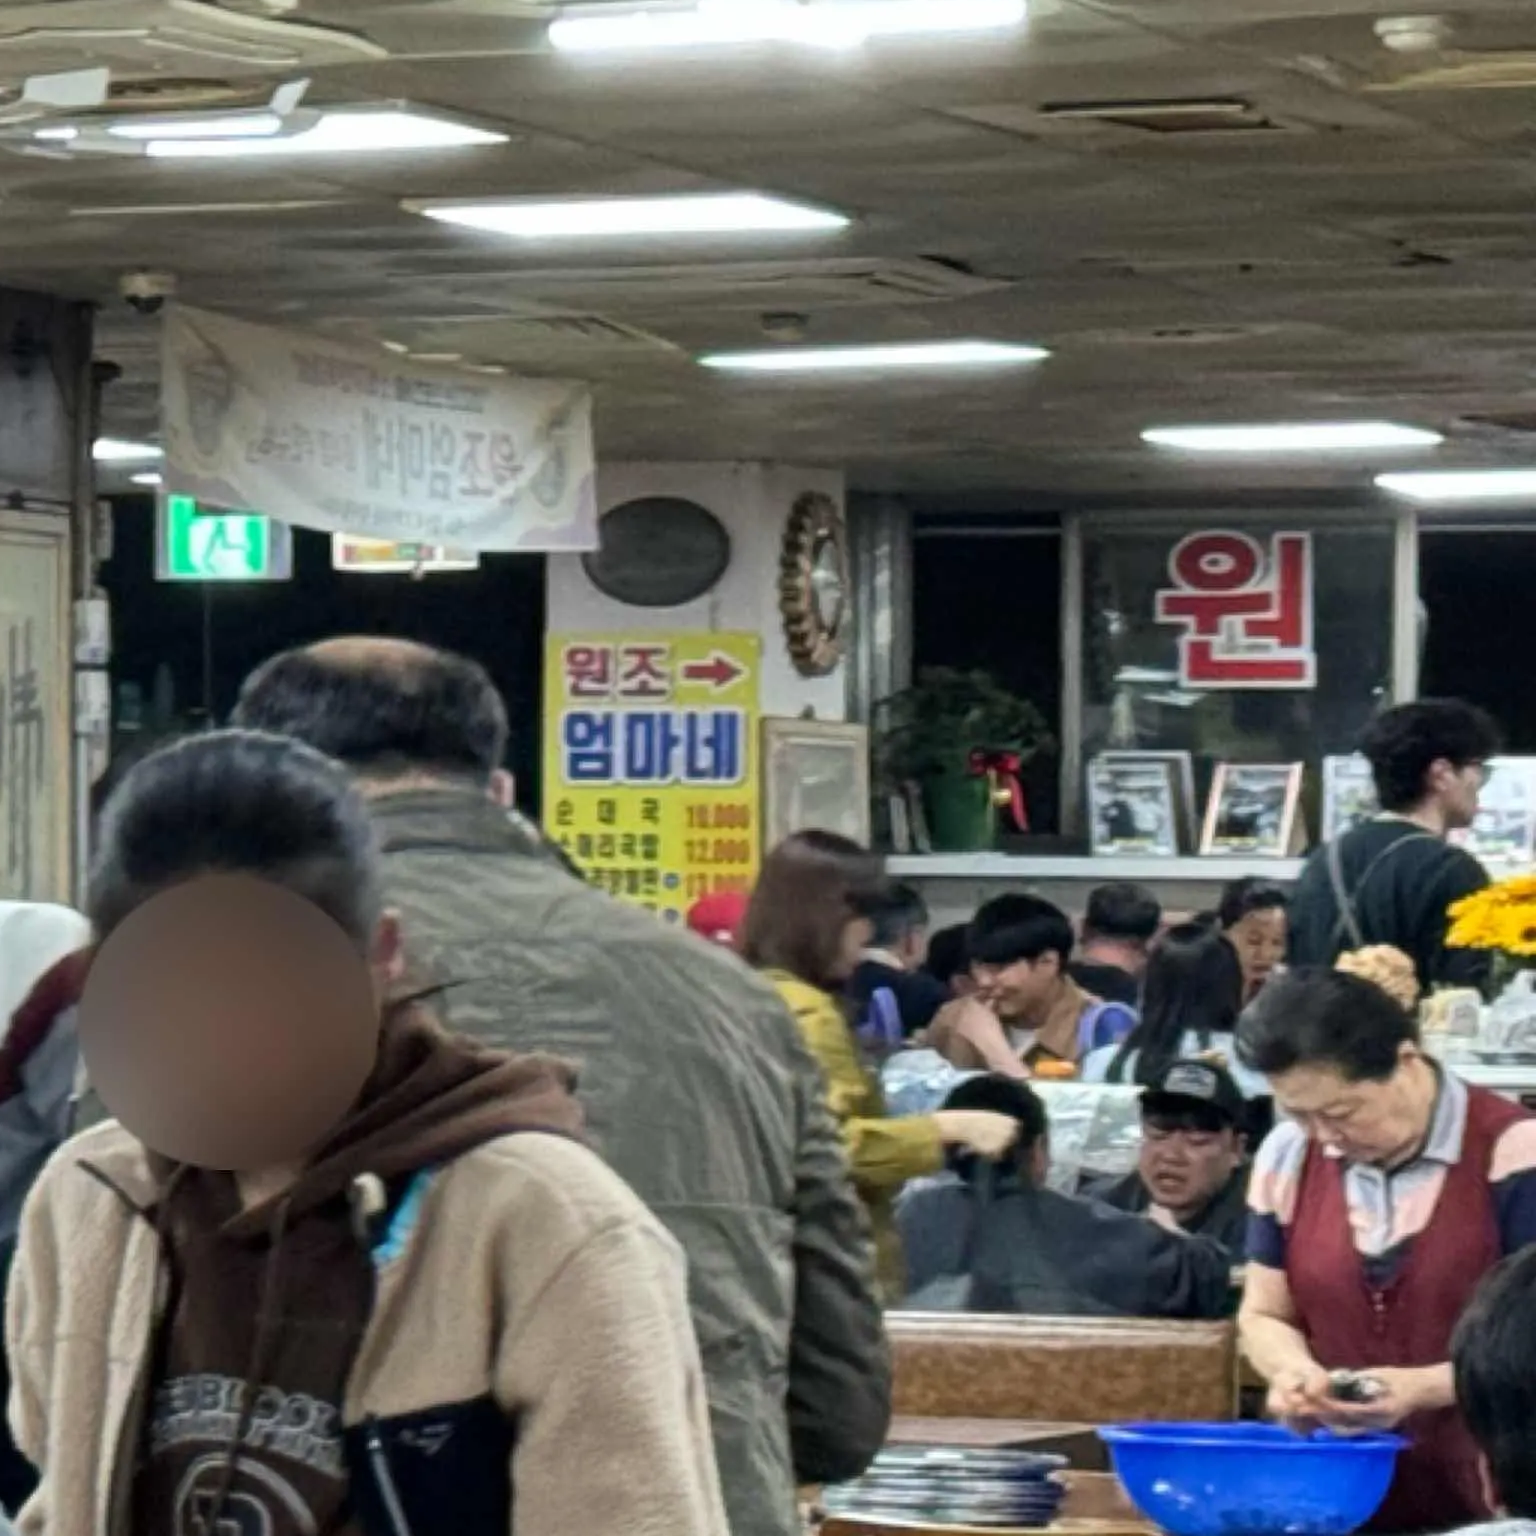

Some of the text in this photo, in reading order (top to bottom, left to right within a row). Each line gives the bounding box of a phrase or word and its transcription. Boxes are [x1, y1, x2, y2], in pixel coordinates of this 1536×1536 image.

[1158, 531, 1314, 686] 원
[563, 646, 668, 697] 원조
[563, 711, 740, 781] 엄마네
